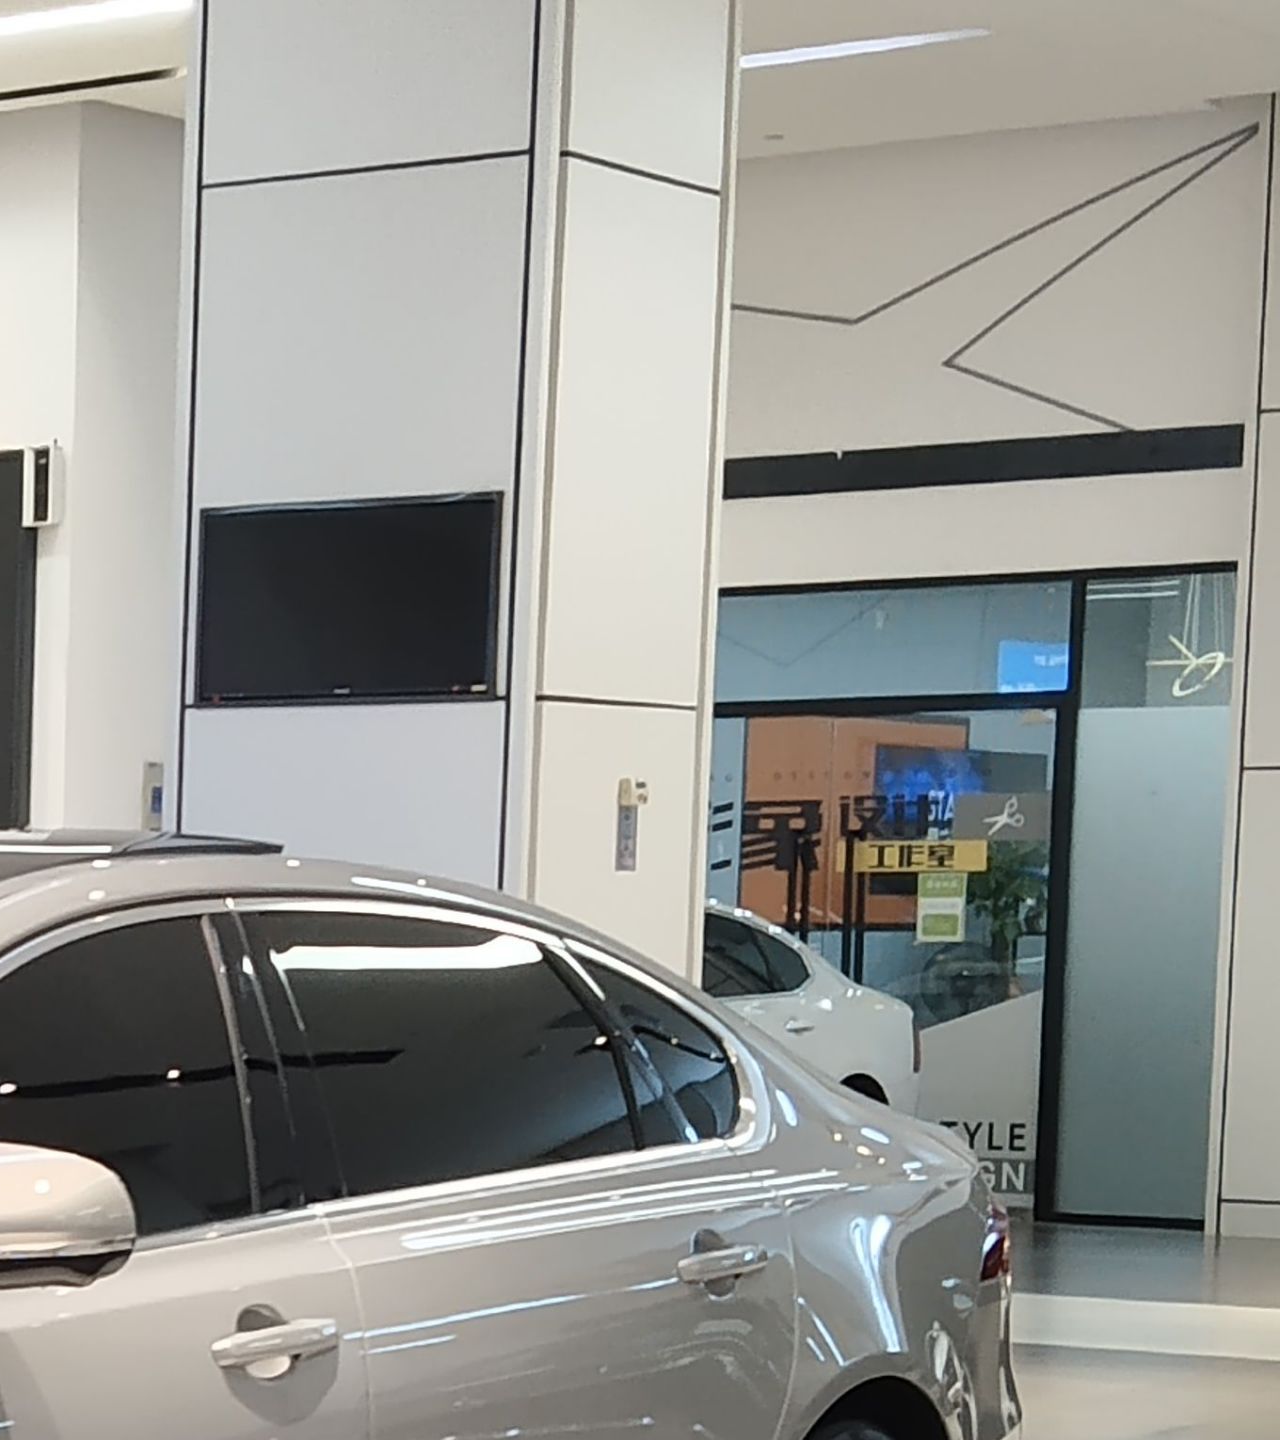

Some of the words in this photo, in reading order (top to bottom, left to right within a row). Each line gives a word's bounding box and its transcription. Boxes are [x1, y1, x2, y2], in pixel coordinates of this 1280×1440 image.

[867, 844, 955, 869] 工作室
[939, 1121, 1026, 1152] YLE
